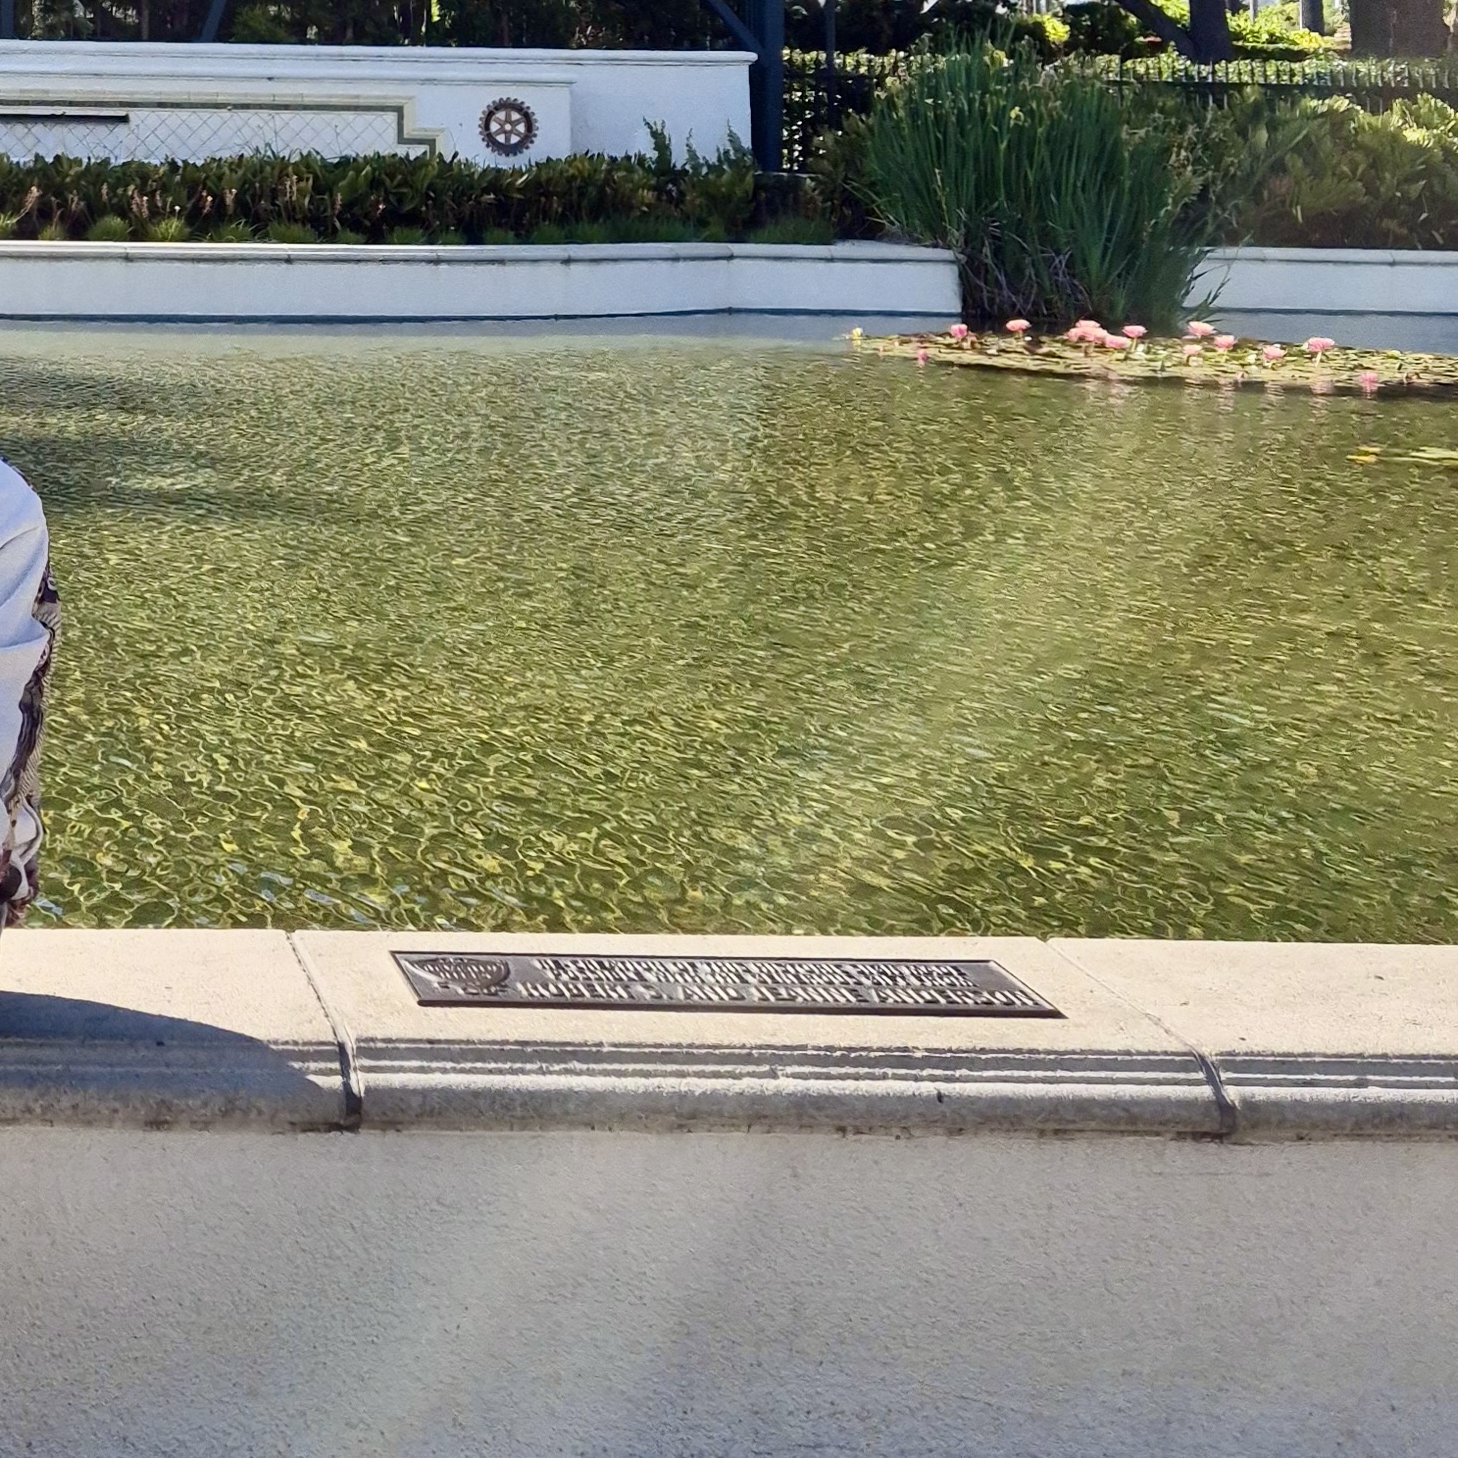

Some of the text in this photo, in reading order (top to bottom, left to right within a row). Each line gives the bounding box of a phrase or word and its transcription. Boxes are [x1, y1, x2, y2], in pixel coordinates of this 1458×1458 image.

[514, 981, 639, 998] ROBERT
[669, 984, 750, 1001] AND
[744, 985, 871, 1003] JEANNE
[861, 989, 1043, 1005] ANDERSON
